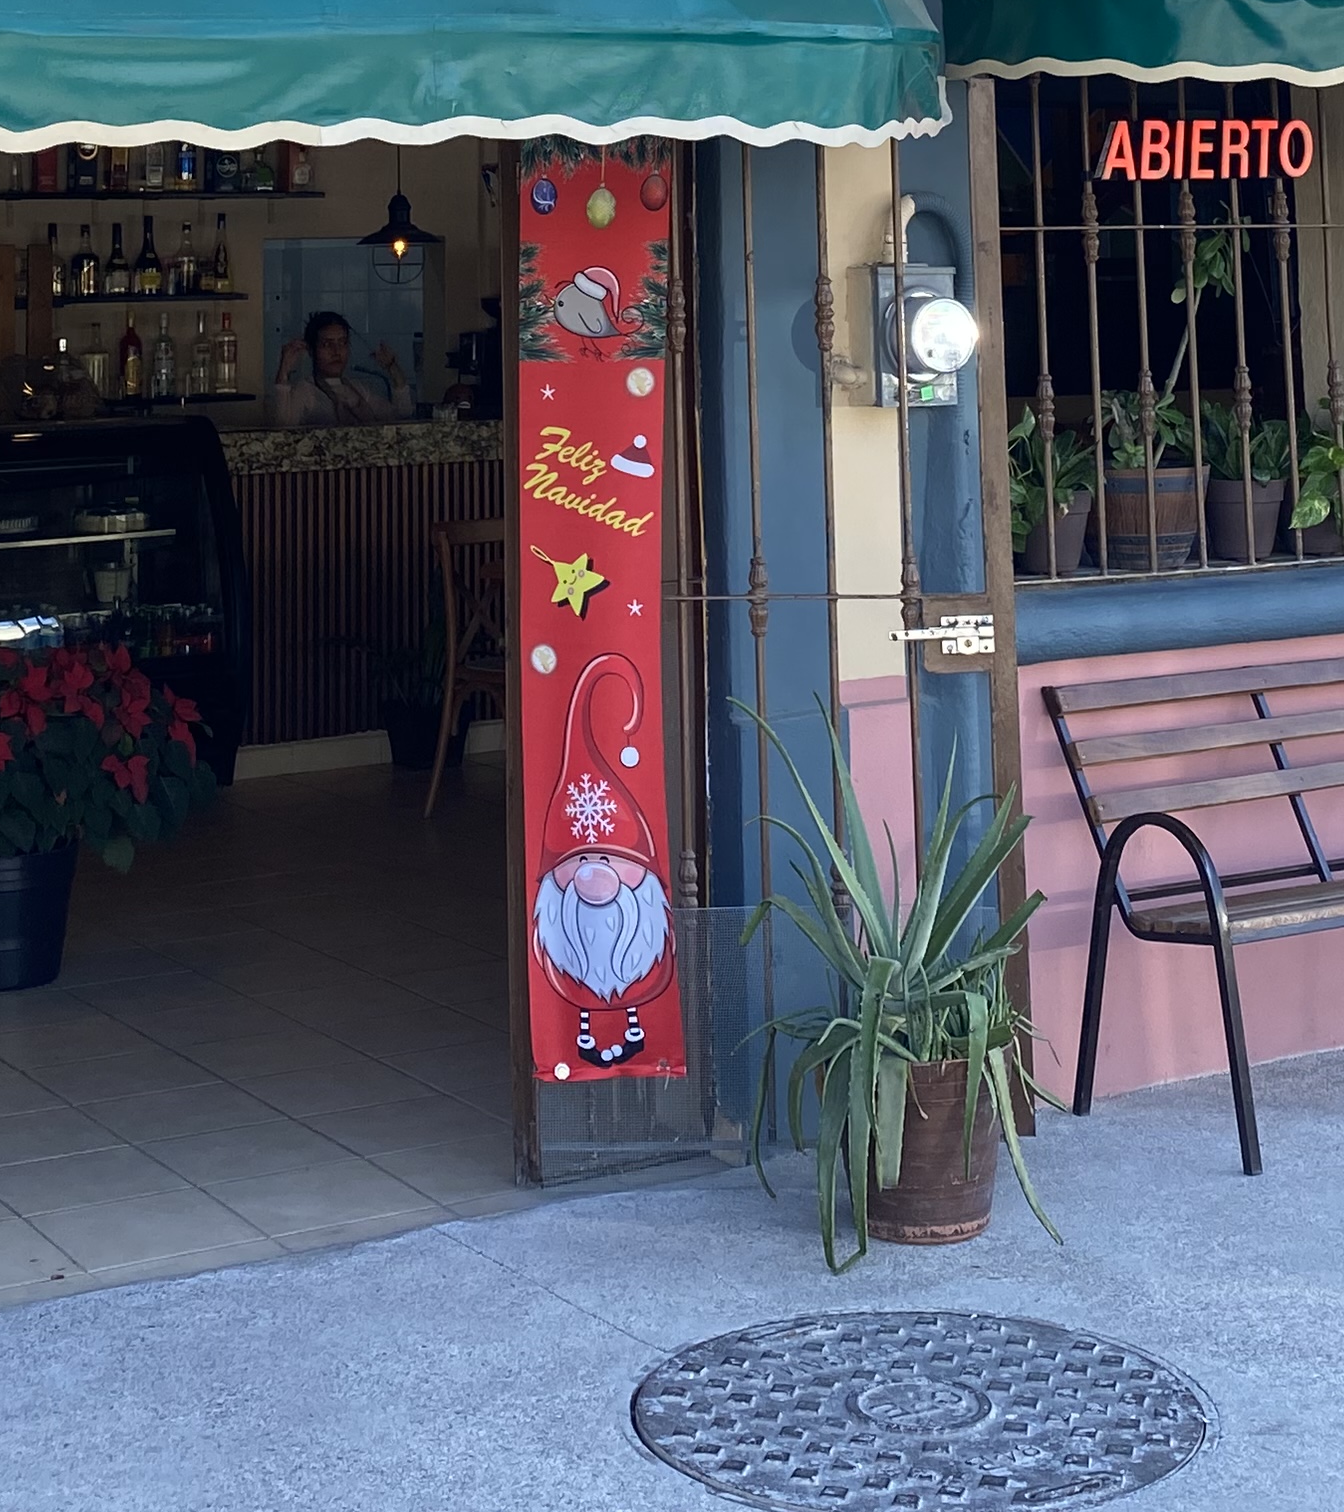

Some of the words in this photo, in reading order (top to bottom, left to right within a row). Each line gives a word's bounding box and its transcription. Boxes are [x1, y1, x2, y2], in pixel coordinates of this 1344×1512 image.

[1100, 119, 1313, 181] ABIERTO
[535, 426, 606, 485] Feliz
[523, 463, 654, 537] Navidad
